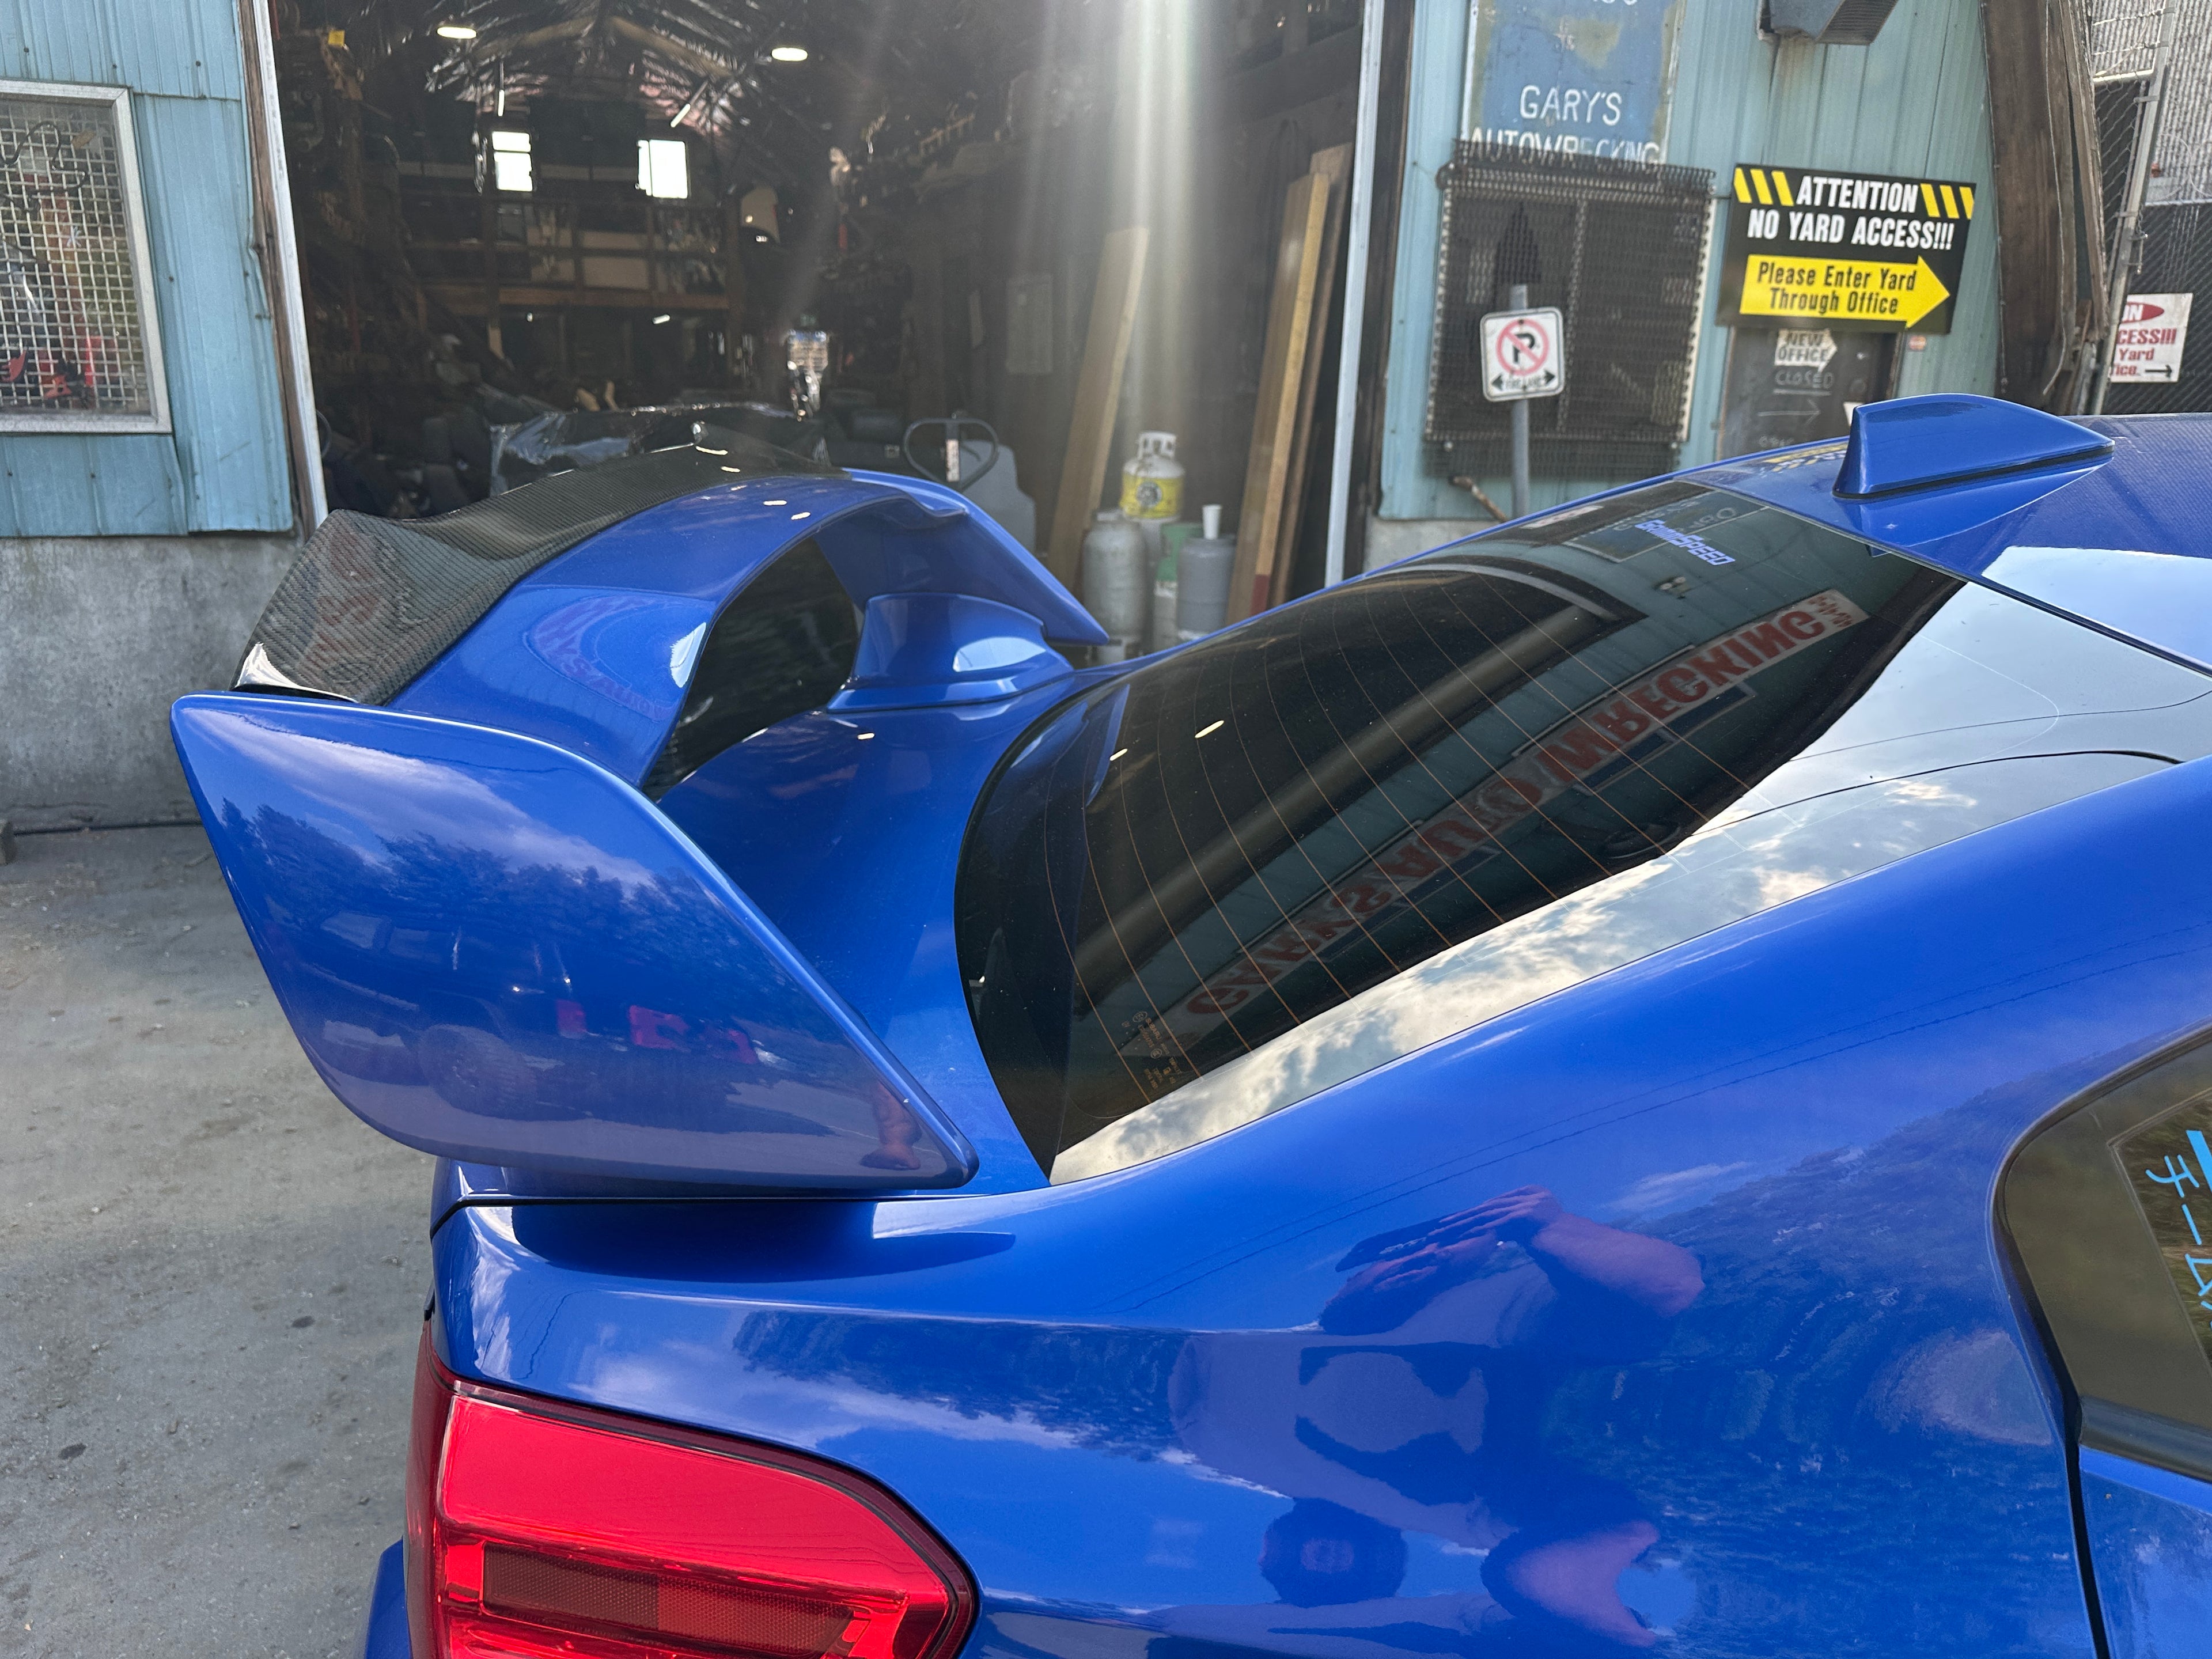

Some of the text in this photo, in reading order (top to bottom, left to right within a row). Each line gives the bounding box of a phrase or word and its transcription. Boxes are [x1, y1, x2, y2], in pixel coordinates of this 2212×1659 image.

[1520, 85, 1622, 126] GARY'S
[1796, 175, 1919, 213] ATTENTION
[1747, 209, 1955, 250] NO YARD ACCESS!!!
[1757, 262, 1916, 291] Please Enter Yard
[1770, 287, 1898, 315] Through Office
[1786, 332, 1824, 346] NEW
[2116, 328, 2177, 344] CESS!!!
[1778, 346, 1828, 362] OFFICE
[2119, 348, 2154, 361] Yard
[1775, 369, 1834, 389] CLOSED
